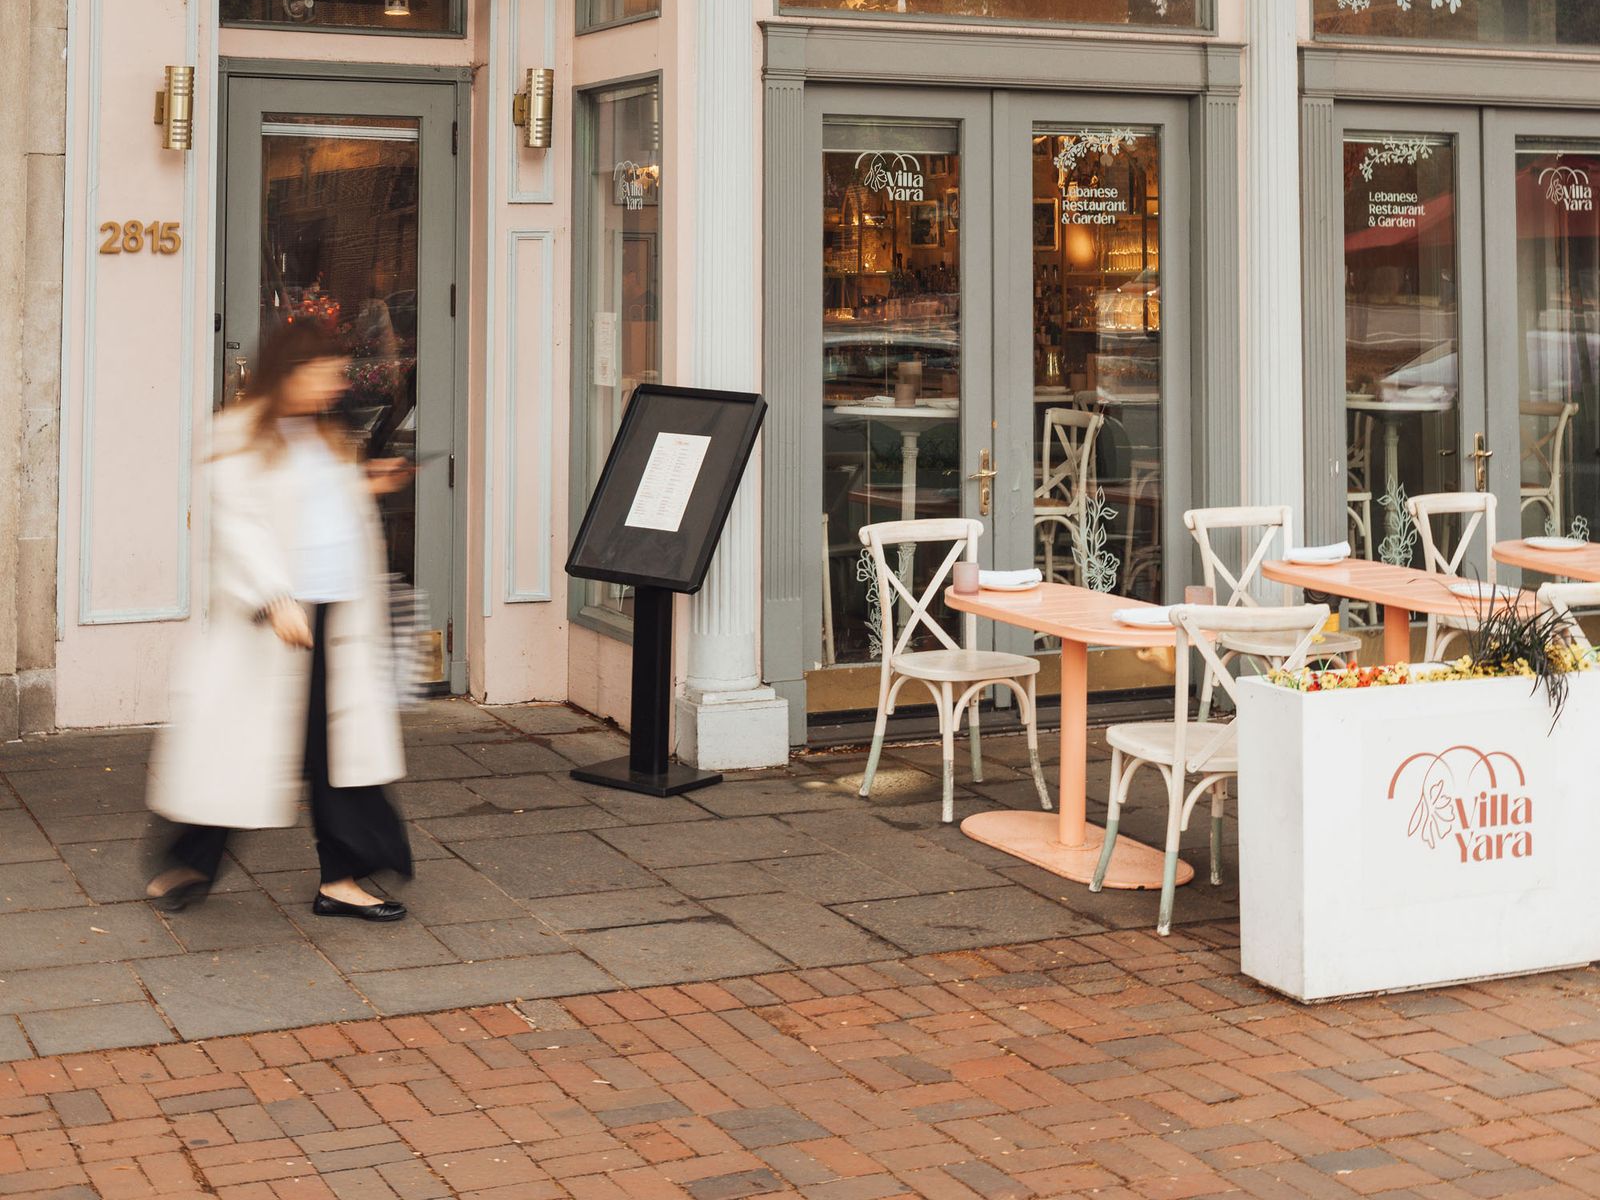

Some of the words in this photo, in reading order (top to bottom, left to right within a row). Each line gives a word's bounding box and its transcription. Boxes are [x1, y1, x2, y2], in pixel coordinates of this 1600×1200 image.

[887, 170, 923, 187] Villa
[886, 186, 923, 201] Yara
[1062, 187, 1118, 198] Lebanese
[1369, 191, 1418, 202] Lebanese
[1563, 184, 1592, 199] Villa
[1062, 200, 1127, 211] Restaurant
[1369, 203, 1425, 216] Restaurant
[1564, 198, 1592, 211] Yara
[1061, 213, 1070, 224] &
[1072, 213, 1116, 224] Garden
[1368, 216, 1376, 227] &
[1377, 216, 1416, 228] Garden
[99, 220, 181, 254] 2815
[1455, 791, 1532, 830] Villa
[1455, 830, 1532, 863] Yara
